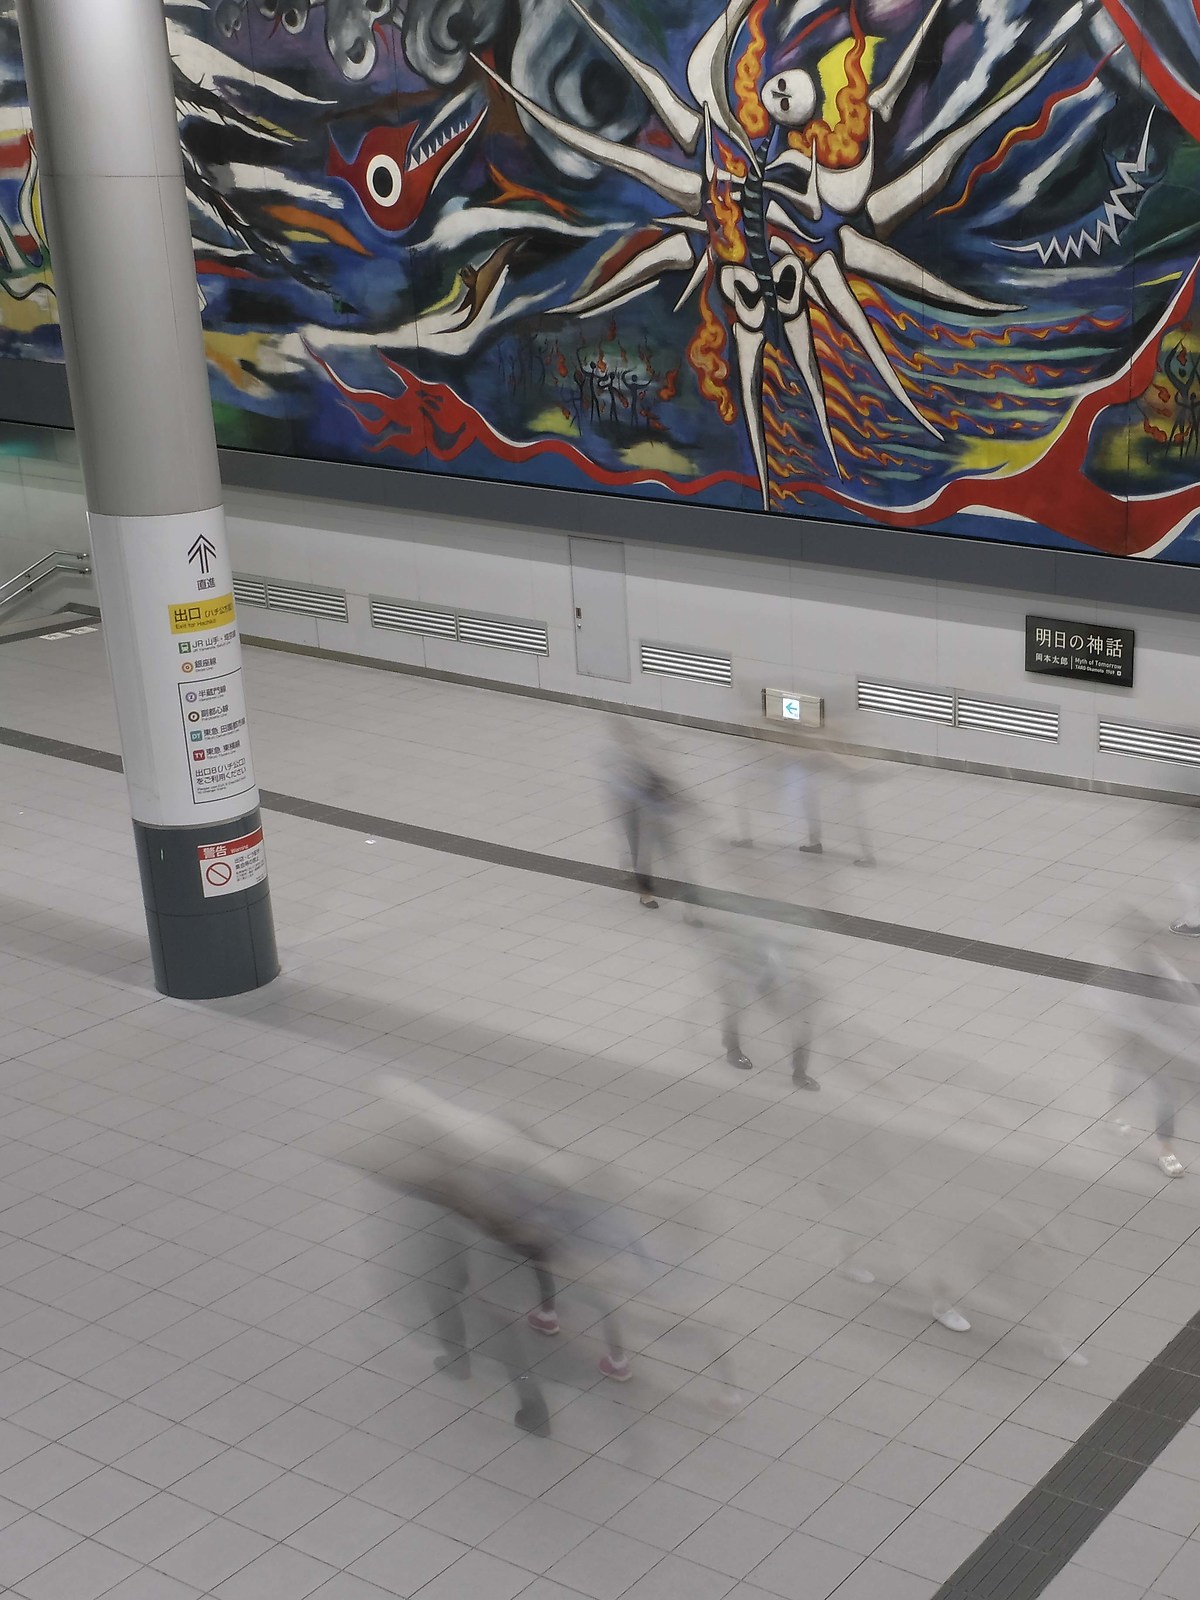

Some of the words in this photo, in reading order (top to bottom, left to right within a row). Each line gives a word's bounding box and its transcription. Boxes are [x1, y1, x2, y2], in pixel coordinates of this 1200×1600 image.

[197, 577, 216, 590] 直進
[174, 607, 201, 622] 出口
[192, 639, 204, 648] JR
[1036, 628, 1124, 658] 明日の神話
[194, 657, 217, 668] 銀座線
[1035, 652, 1069, 666] 岡本太郎
[1074, 657, 1088, 665] Myth
[1095, 660, 1122, 669] Tomorrow
